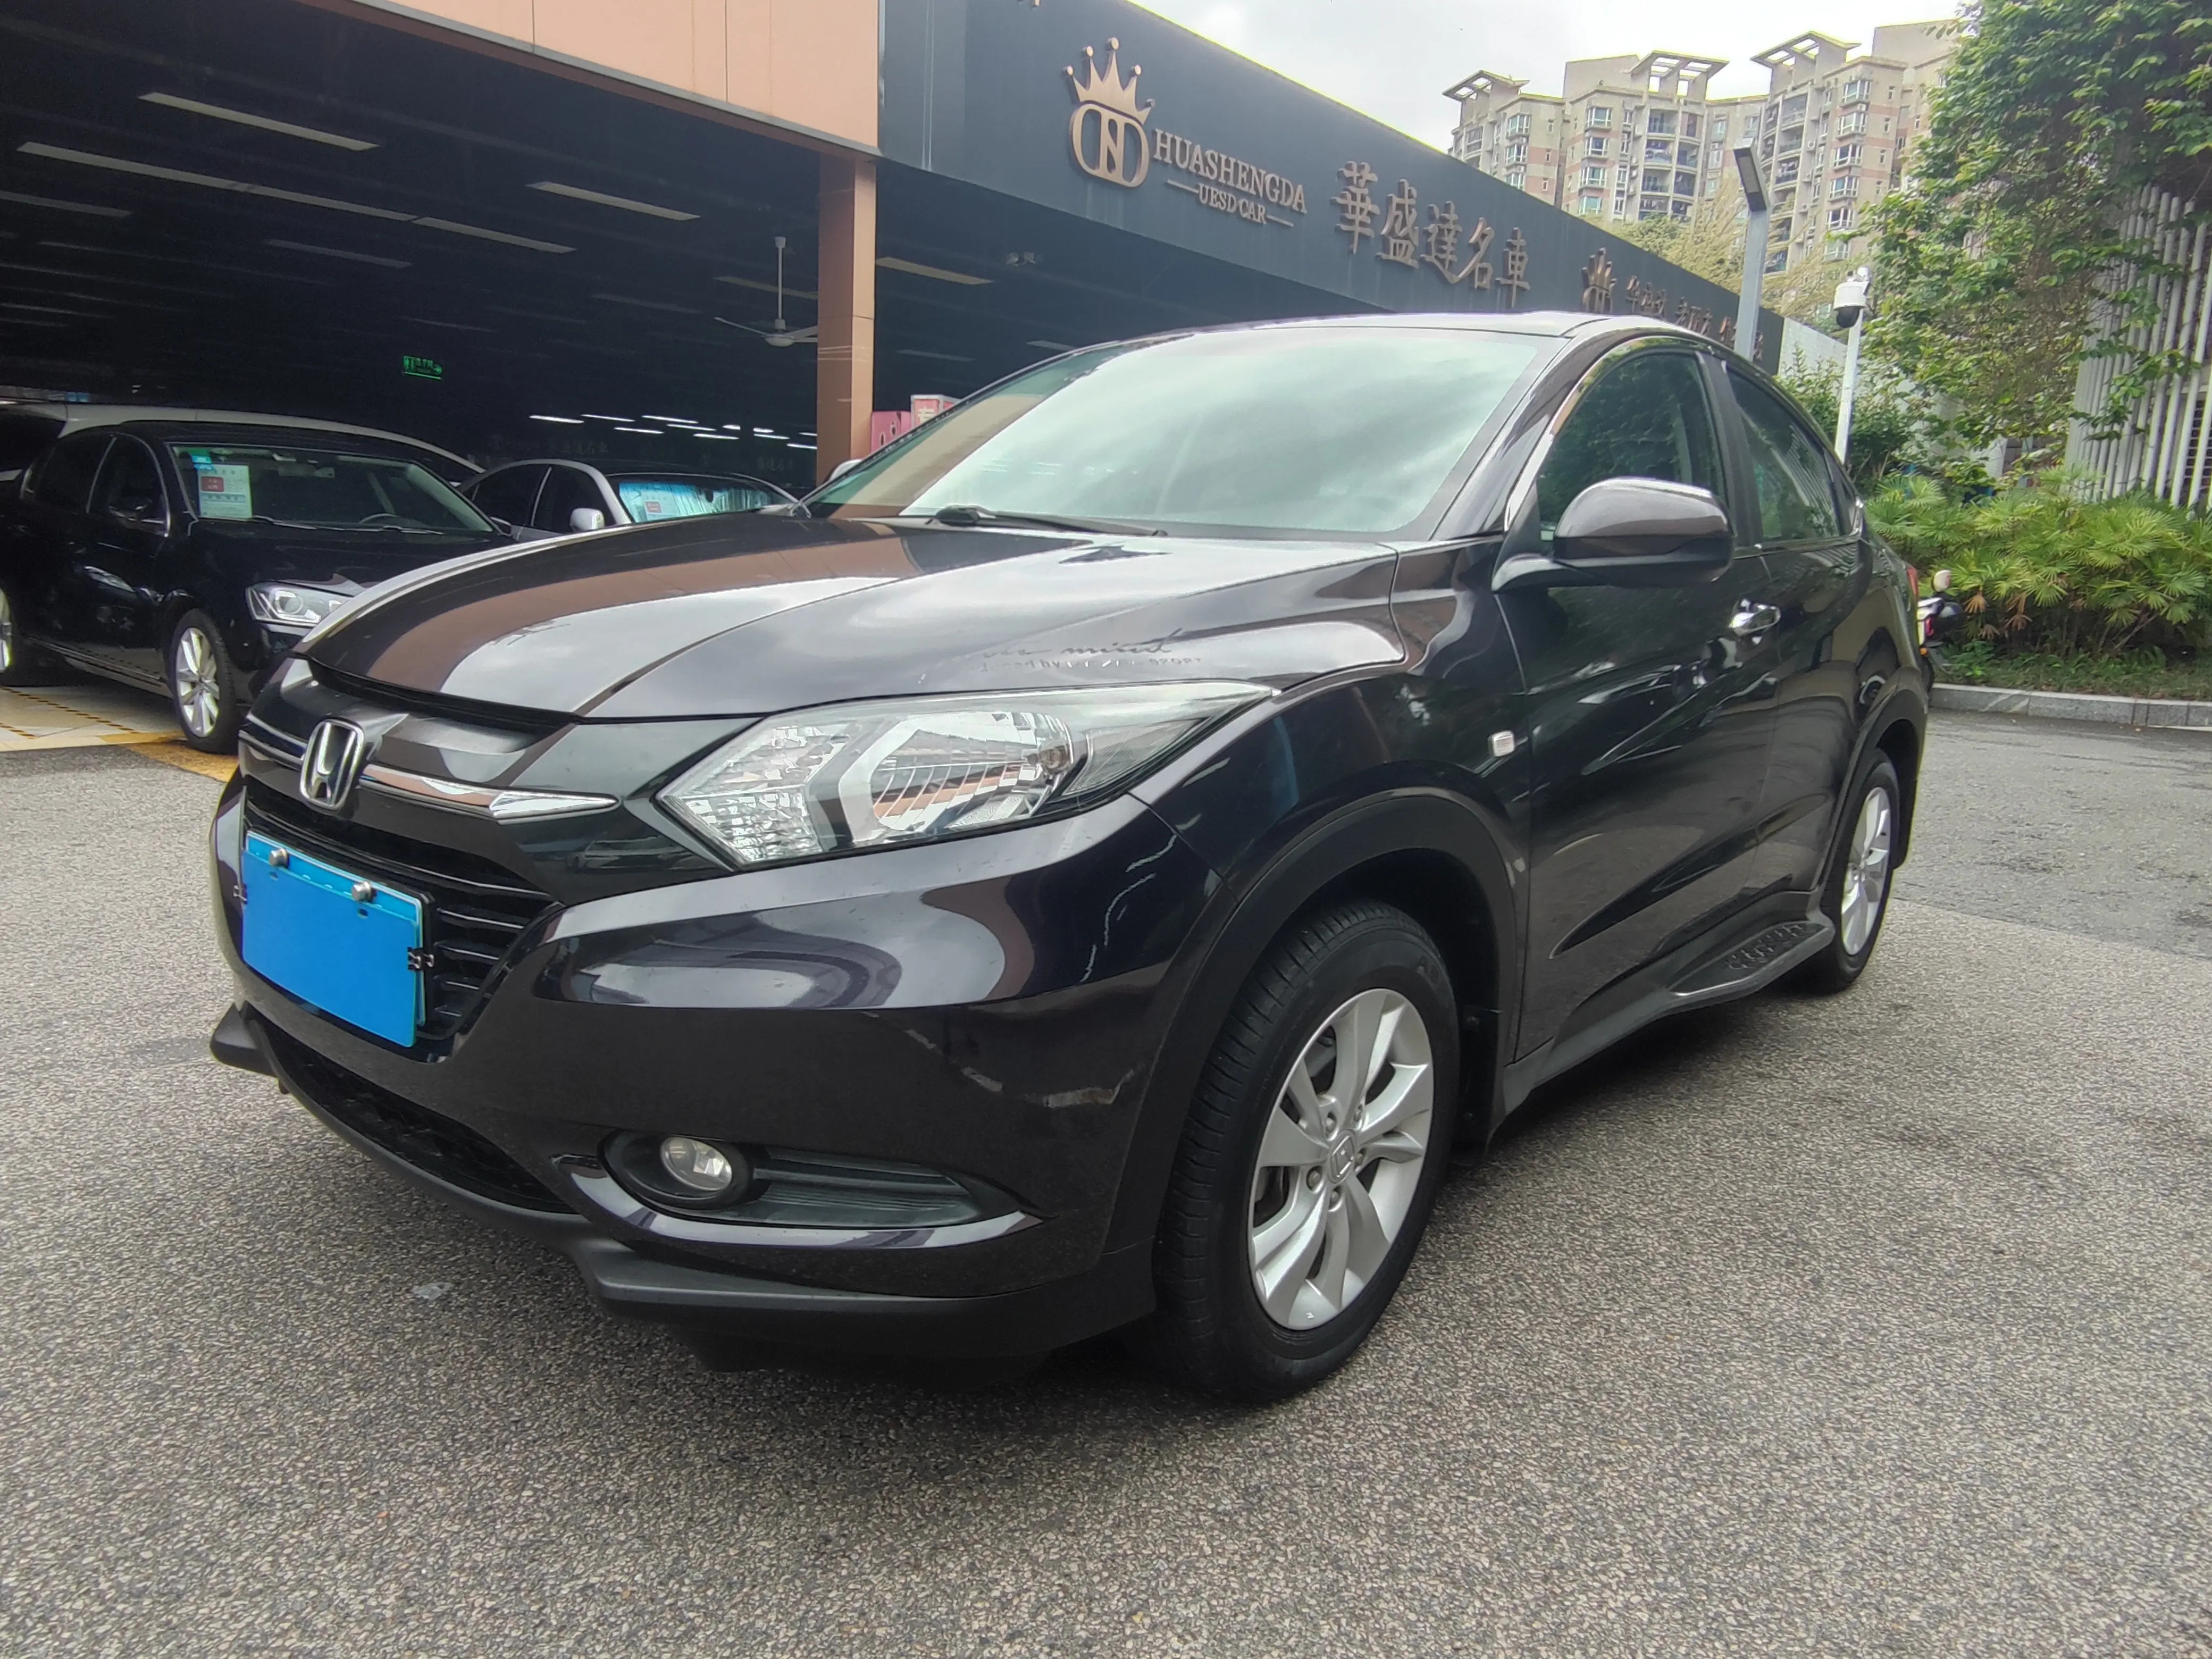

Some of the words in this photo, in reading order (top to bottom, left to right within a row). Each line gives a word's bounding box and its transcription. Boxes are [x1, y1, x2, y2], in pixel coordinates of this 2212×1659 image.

[1153, 128, 1308, 214] HUASHENGDA
[1197, 182, 1237, 213] UESD
[1238, 198, 1267, 224] CAR
[1331, 161, 1531, 308] 華盛達名車
